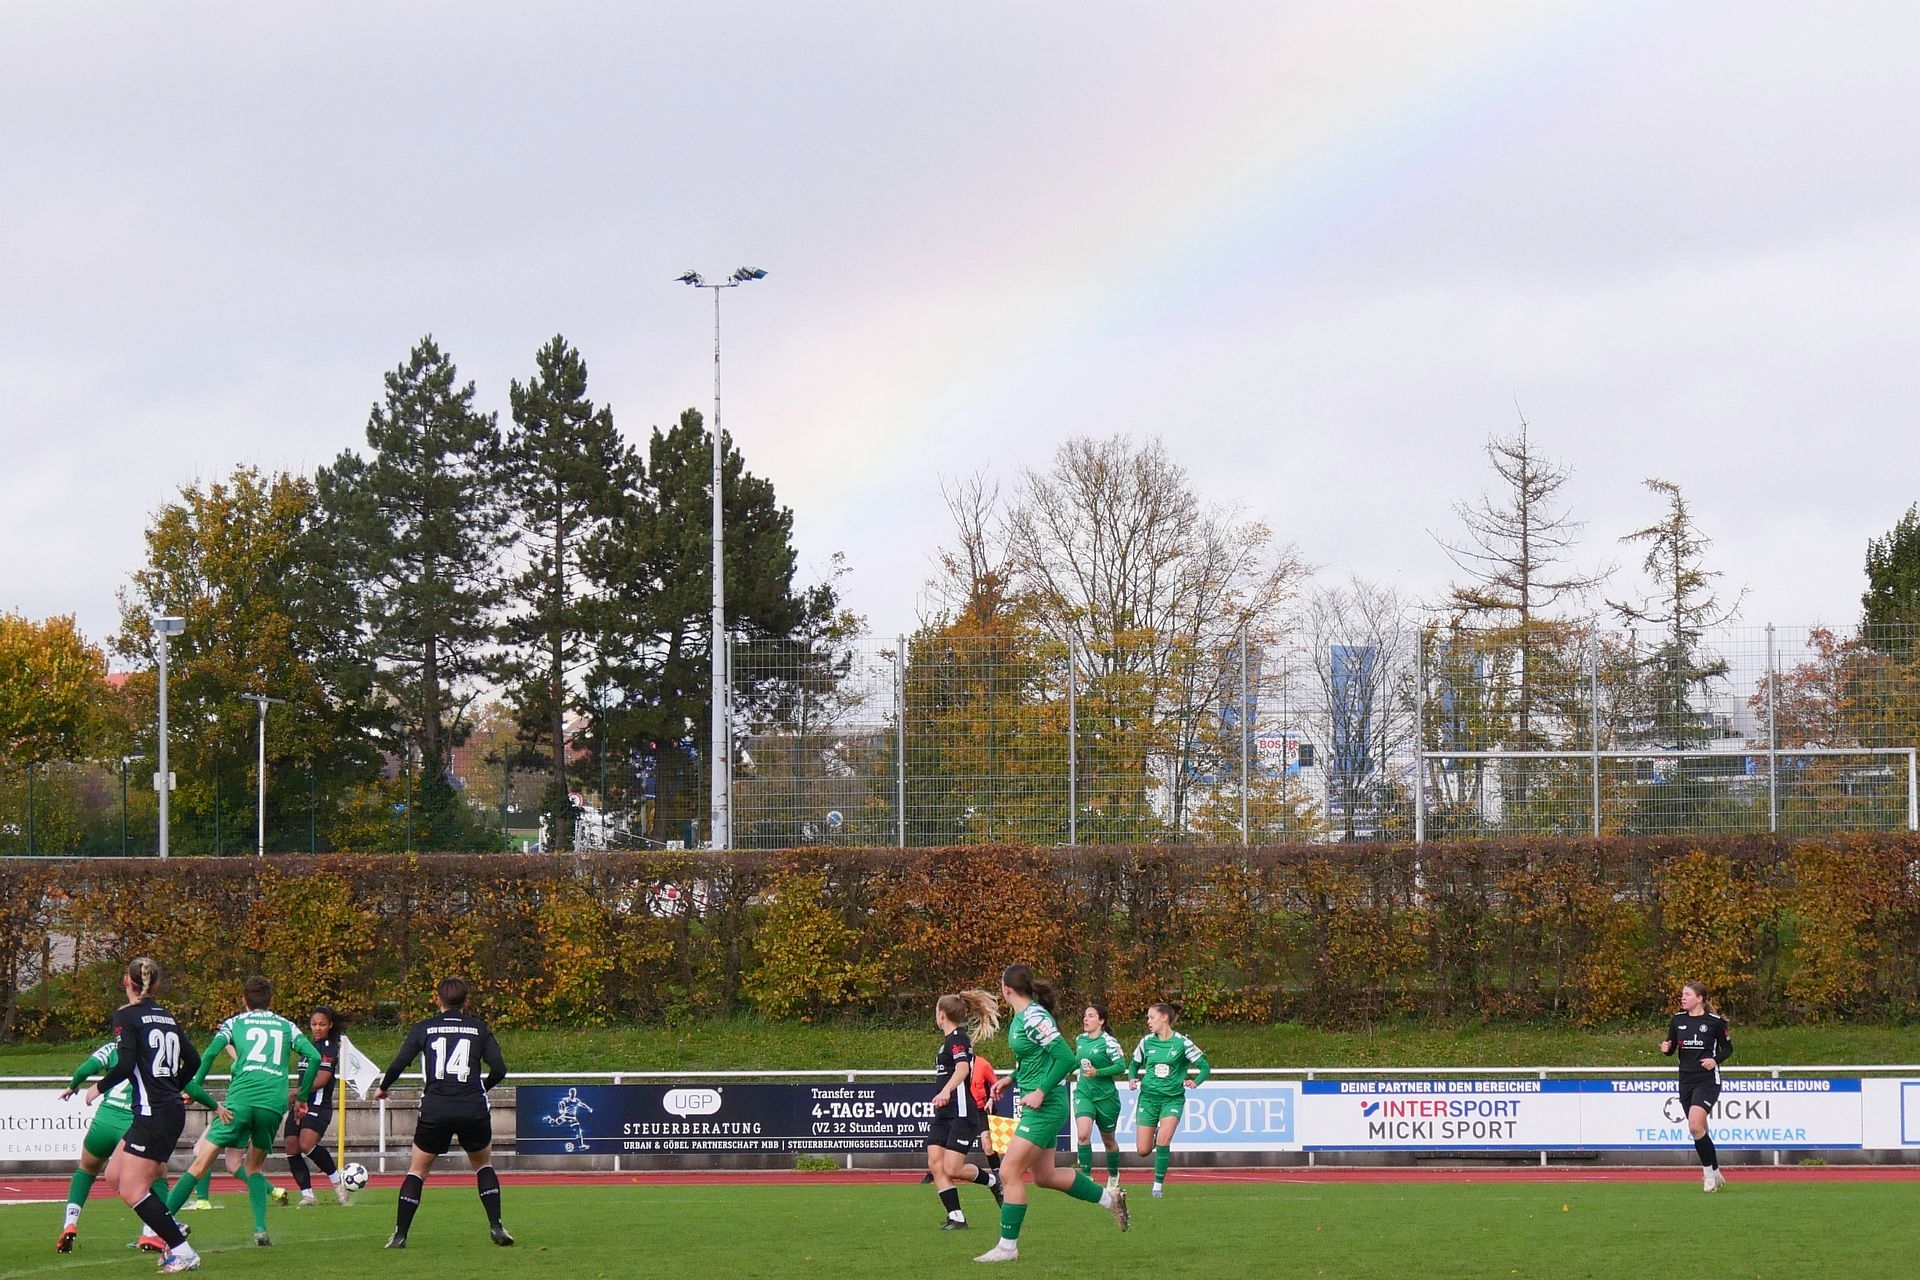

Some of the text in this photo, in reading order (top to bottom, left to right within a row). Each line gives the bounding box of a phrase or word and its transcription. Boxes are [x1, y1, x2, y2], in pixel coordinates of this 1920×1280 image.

[1259, 749, 1297, 759] Servce
[427, 1026, 479, 1036] KSV HESSEN KASSEL
[149, 1028, 180, 1078] 20
[246, 1027, 283, 1066] 21
[431, 1036, 471, 1083] 14
[1341, 1081, 1541, 1093] DEINE PARTNER IN DEN BEREICHEN
[1721, 1080, 1830, 1091] RMENBEKLEIDUNG
[811, 1088, 875, 1099] Transfer zur
[675, 1094, 713, 1109] UGP
[811, 1102, 936, 1119] 4-TAGE-WOCH
[1383, 1100, 1521, 1118] INTERSPORT
[1709, 1100, 1770, 1119] ICKI
[623, 1122, 762, 1135] STEUERBERATUNG
[812, 1122, 830, 1135] (VZ
[833, 1122, 846, 1133] 32
[849, 1121, 893, 1133] Stunden
[897, 1124, 915, 1135] pro
[1369, 1120, 1517, 1139] MICKI SPORT
[1636, 1128, 1682, 1141] TEAM
[8, 1144, 77, 1153] ELANDERS
[623, 1141, 651, 1150] URBAN
[654, 1141, 661, 1150] &
[663, 1139, 689, 1150] GÖBEL
[692, 1140, 759, 1150] PARTNERSCHAFT
[761, 1140, 779, 1150] MBB
[788, 1140, 924, 1150] STEUERBERATUNGSGESELLSCHAFT
